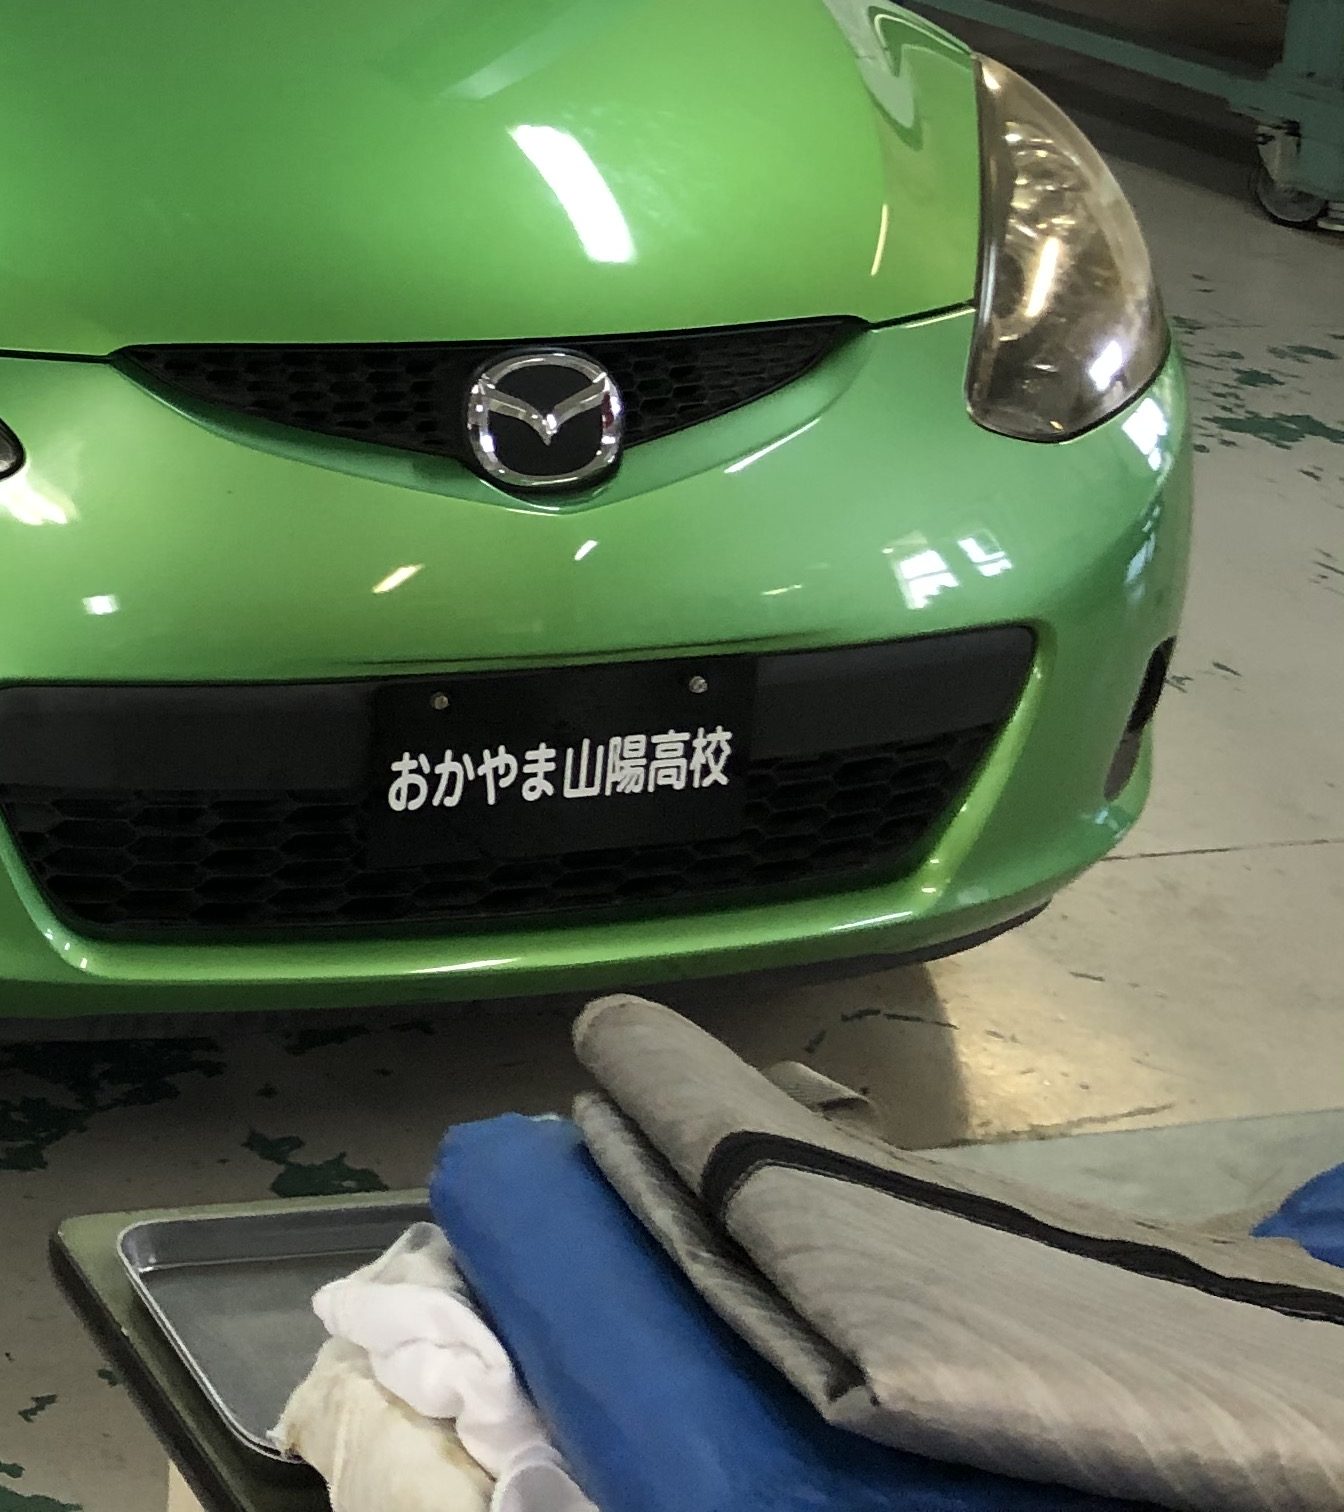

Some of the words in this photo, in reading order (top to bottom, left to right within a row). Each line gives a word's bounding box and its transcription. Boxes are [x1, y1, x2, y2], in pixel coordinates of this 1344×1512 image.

[387, 725, 733, 812] おかやま山陽高校
